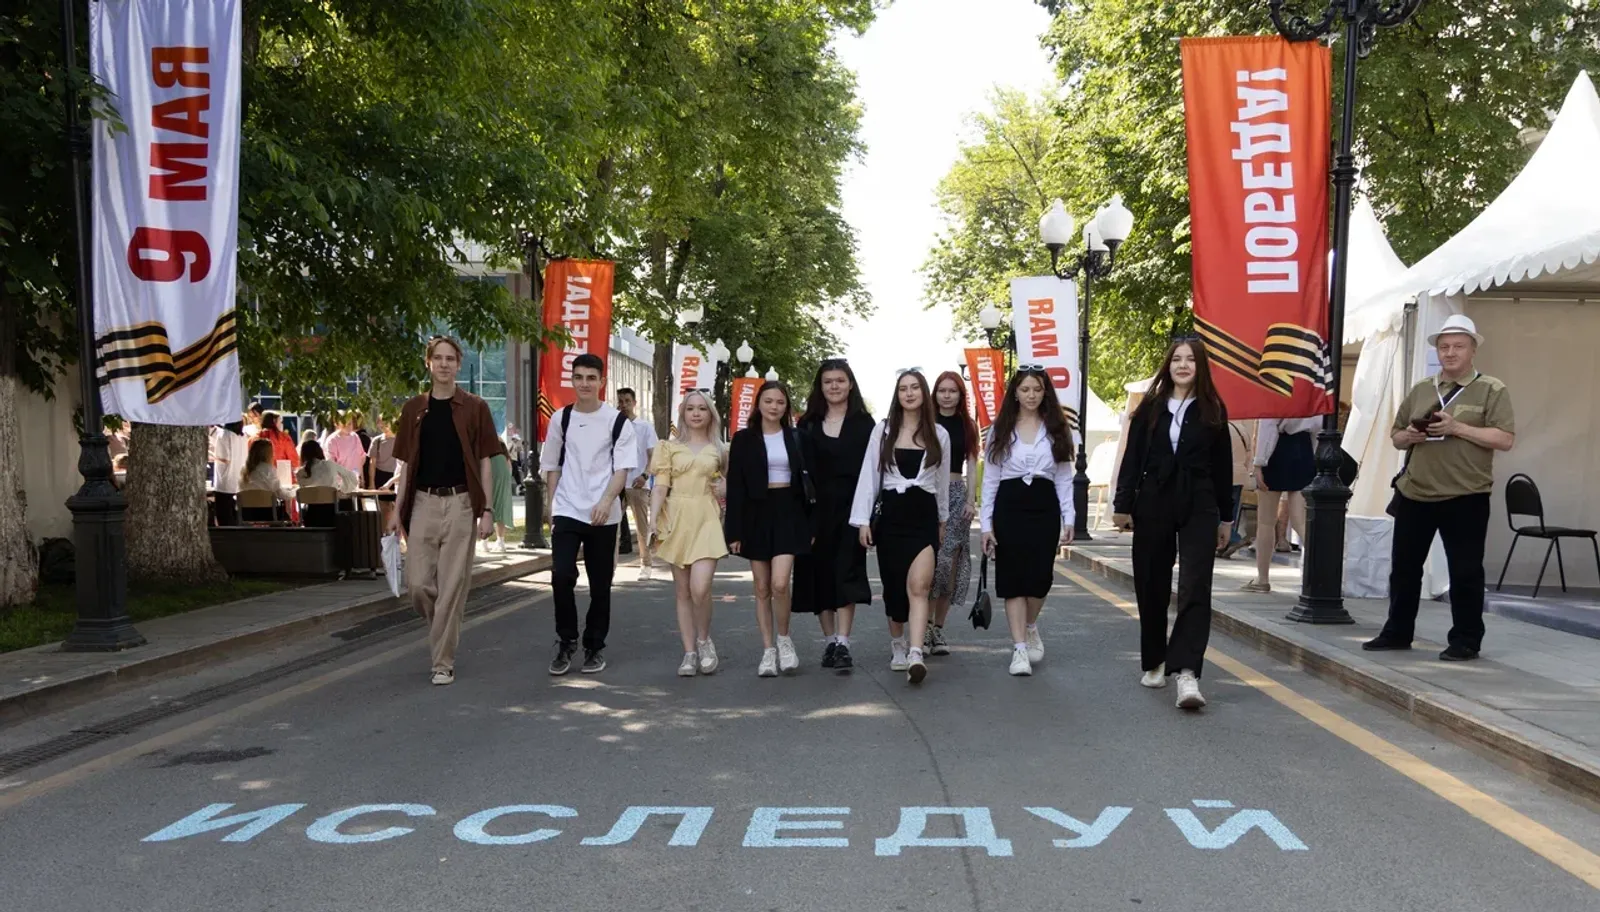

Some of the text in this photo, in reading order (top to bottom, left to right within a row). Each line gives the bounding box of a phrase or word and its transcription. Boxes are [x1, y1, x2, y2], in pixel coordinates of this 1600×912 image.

[127, 46, 212, 284] 9 МАЯ
[140, 799, 1309, 857] ИССЛЕДУЙ
